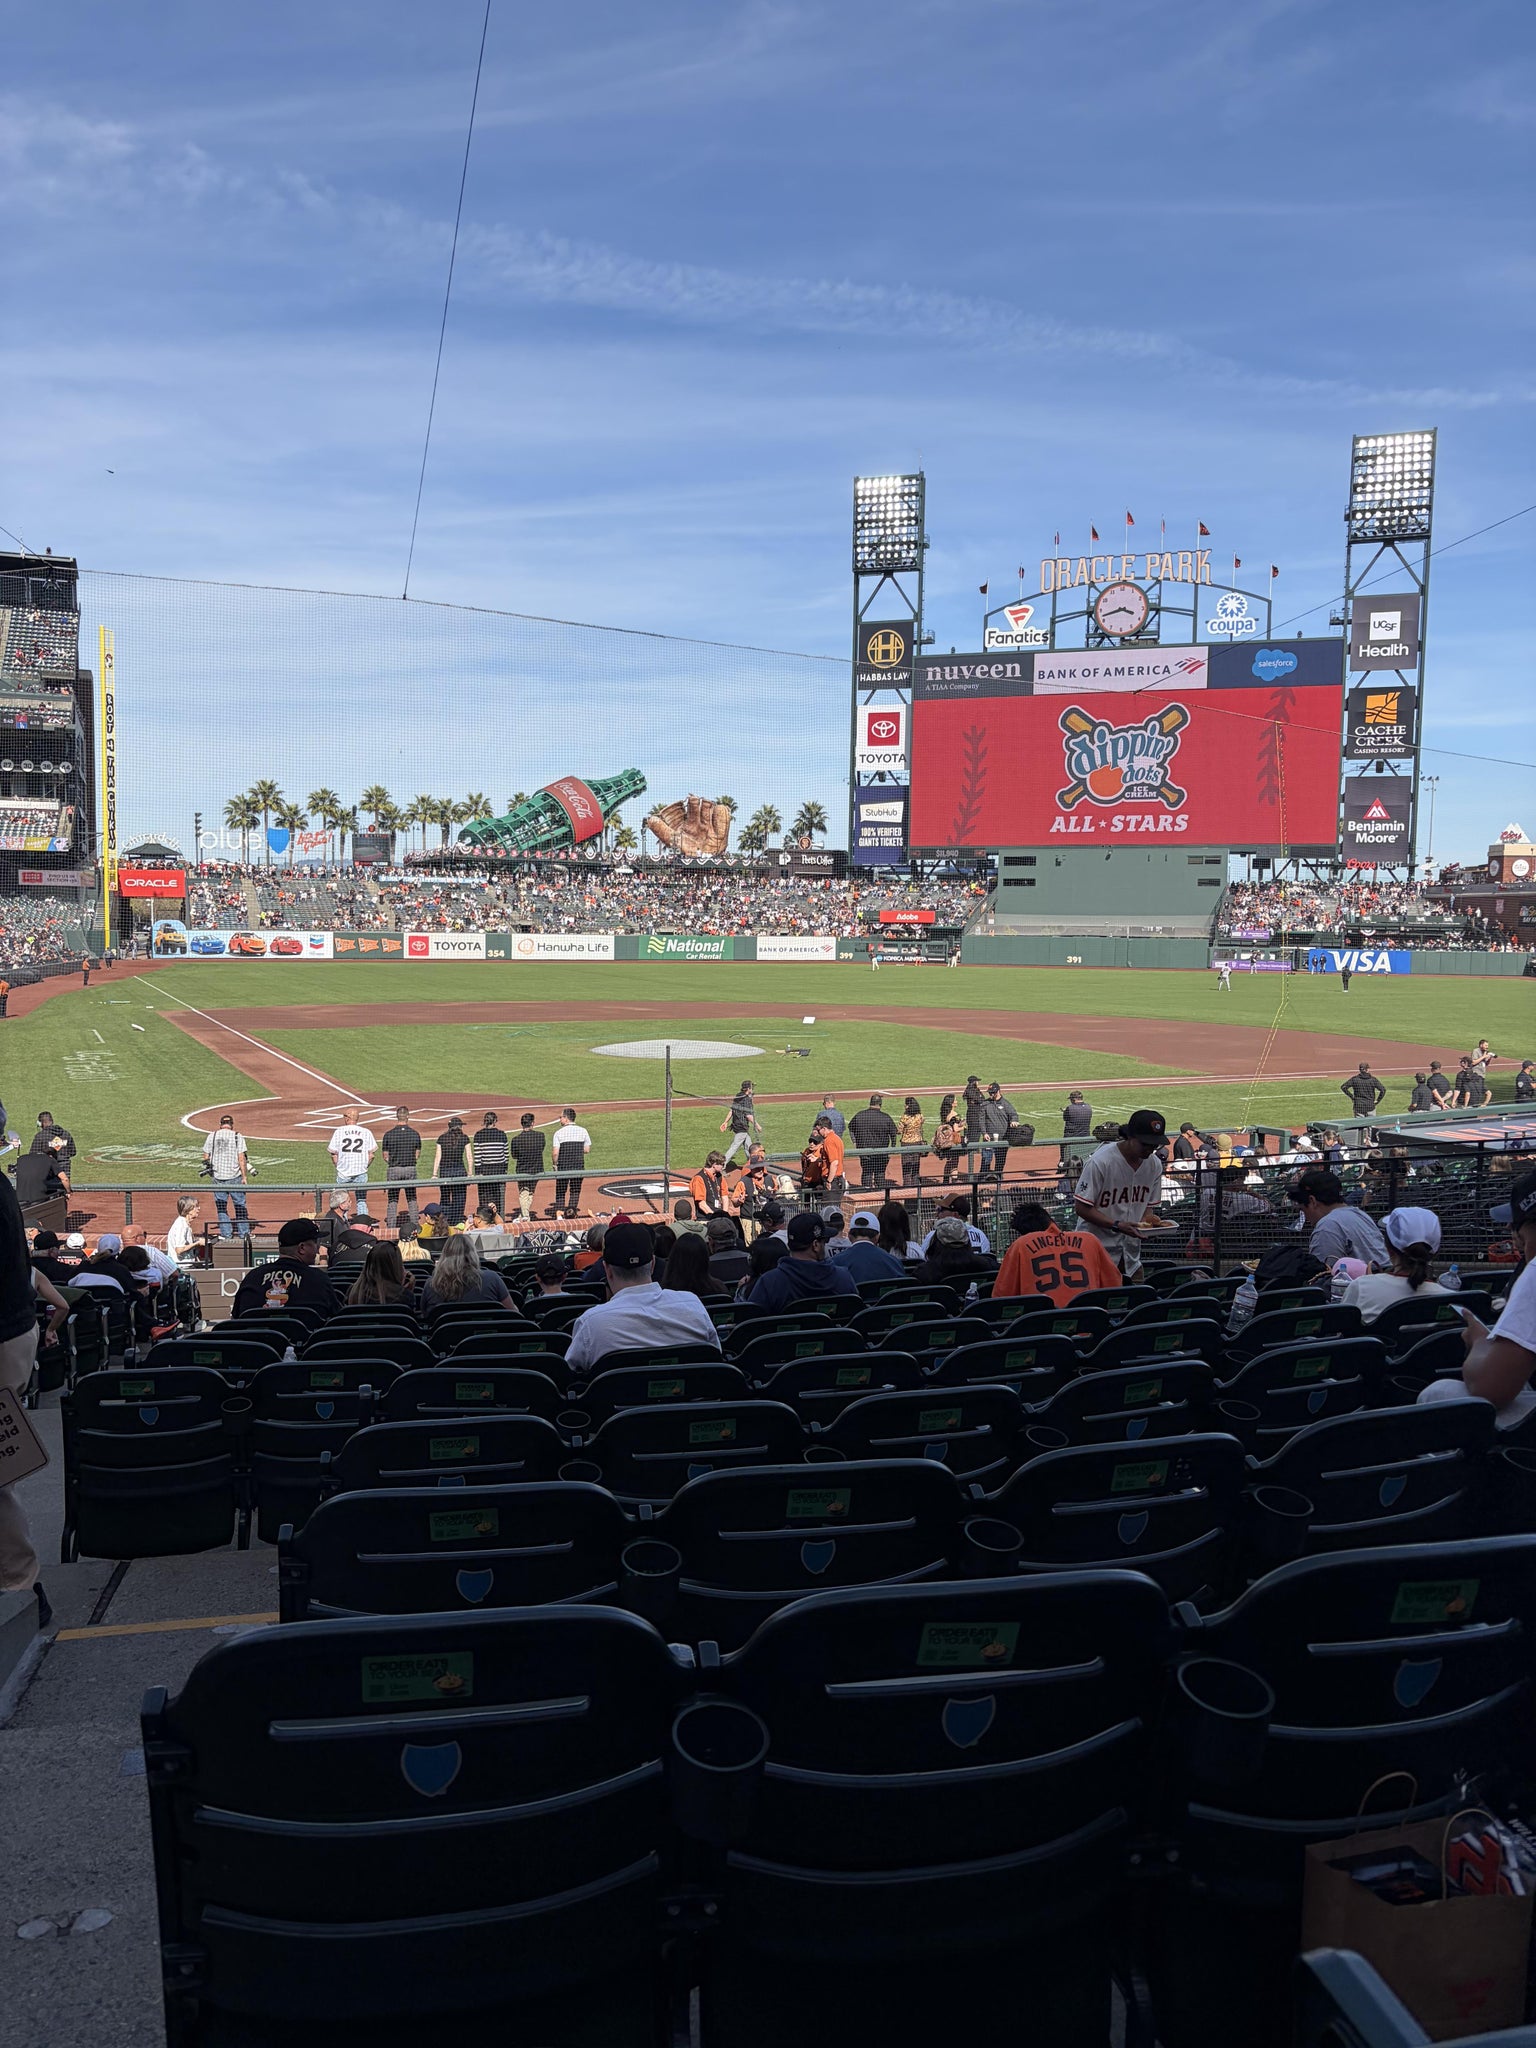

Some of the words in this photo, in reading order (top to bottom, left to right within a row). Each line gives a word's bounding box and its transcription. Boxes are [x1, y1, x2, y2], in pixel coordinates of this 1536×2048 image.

[1040, 554, 1135, 593] ORACLE
[1145, 549, 1212, 585] PARK
[1210, 618, 1253, 634] coupa
[1373, 620, 1397, 631] UCSF
[987, 629, 1048, 644] Fanatics
[1359, 643, 1409, 657] Health
[1258, 658, 1293, 668] salesforce
[860, 673, 892, 682] HABBAS
[893, 672, 910, 680] LAW
[926, 662, 1022, 681] nuveen
[1038, 669, 1077, 680] BANK
[1081, 668, 1100, 678] OF
[1103, 665, 1171, 678] AMERICA
[950, 683, 979, 691] Company
[1355, 725, 1407, 736] CACHE
[1356, 736, 1404, 747] CREEK
[1070, 723, 1173, 775] dippin'
[859, 753, 907, 764] TOYOTA
[1122, 765, 1160, 784] dots
[865, 808, 898, 817] StubHub
[1050, 815, 1095, 833] ALL
[1110, 814, 1189, 833] STARS
[1348, 821, 1405, 833] Benjamin
[861, 827, 876, 837] 100%
[877, 827, 902, 837] VERIFIED
[1355, 832, 1396, 844] Moore
[200, 828, 262, 850] blue
[858, 837, 879, 847] GIANTS
[880, 837, 904, 847] TICKETS
[817, 855, 834, 866] Coffee
[1346, 858, 1377, 870] Coors
[1378, 860, 1403, 869] LIGHT
[125, 878, 178, 887] ORACLE
[434, 941, 482, 951] TOYOTA
[537, 942, 585, 952] Hanwha
[588, 942, 609, 952] Life
[667, 939, 724, 953] National
[487, 949, 505, 958] 354
[839, 952, 853, 960] 399
[1066, 955, 1082, 964] 391
[1328, 951, 1391, 971] VISA
[341, 1138, 364, 1153] 22
[1031, 1252, 1089, 1292] 55
[262, 1270, 302, 1288] PICON
